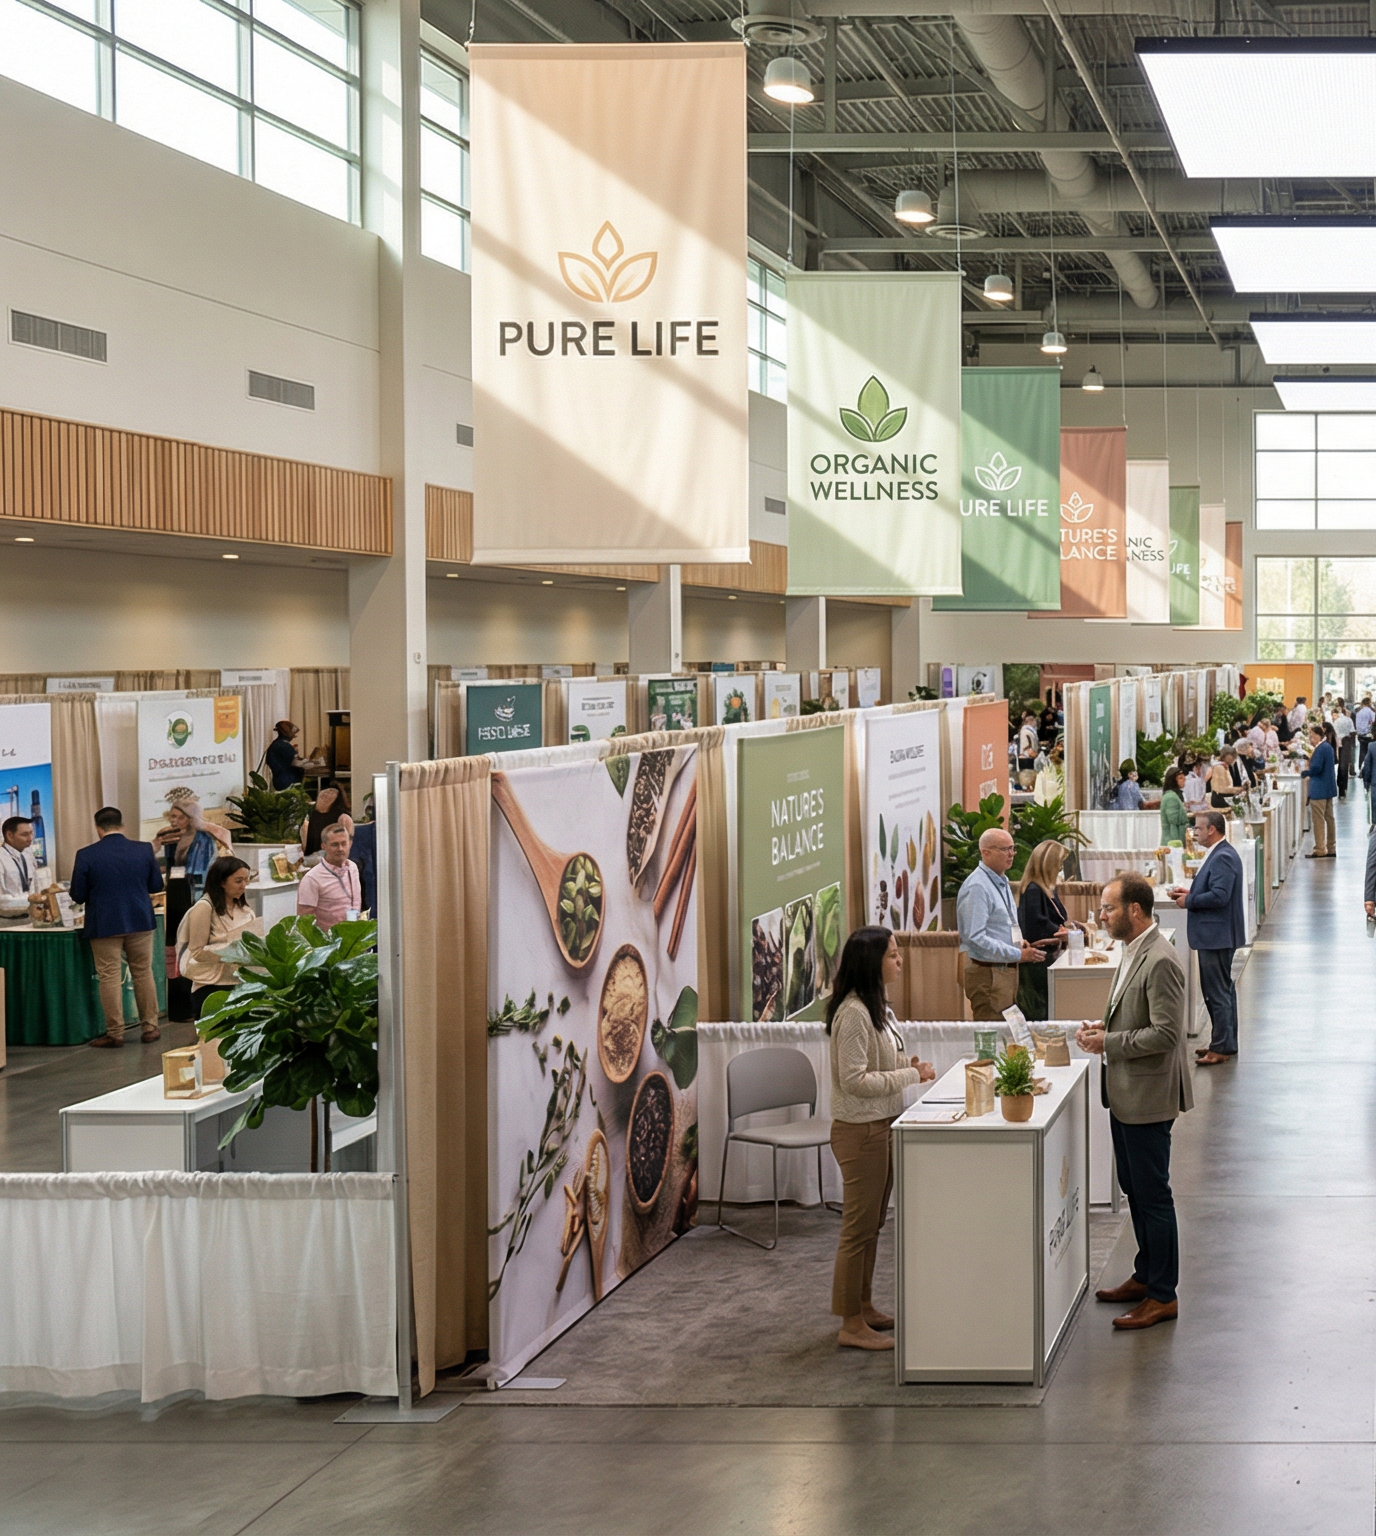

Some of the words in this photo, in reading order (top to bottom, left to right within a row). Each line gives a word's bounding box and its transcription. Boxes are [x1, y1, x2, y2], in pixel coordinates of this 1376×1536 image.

[499, 321, 616, 356] PURE
[631, 321, 719, 356] LIFE
[810, 453, 938, 475] ORGANIC
[810, 481, 939, 502] WELLNESS
[960, 499, 1001, 517] URE
[1007, 499, 1049, 517] LIFE
[1060, 528, 1118, 543] TURE'S
[1060, 545, 1118, 560] LANCE
[771, 822, 824, 866] BALANCE
